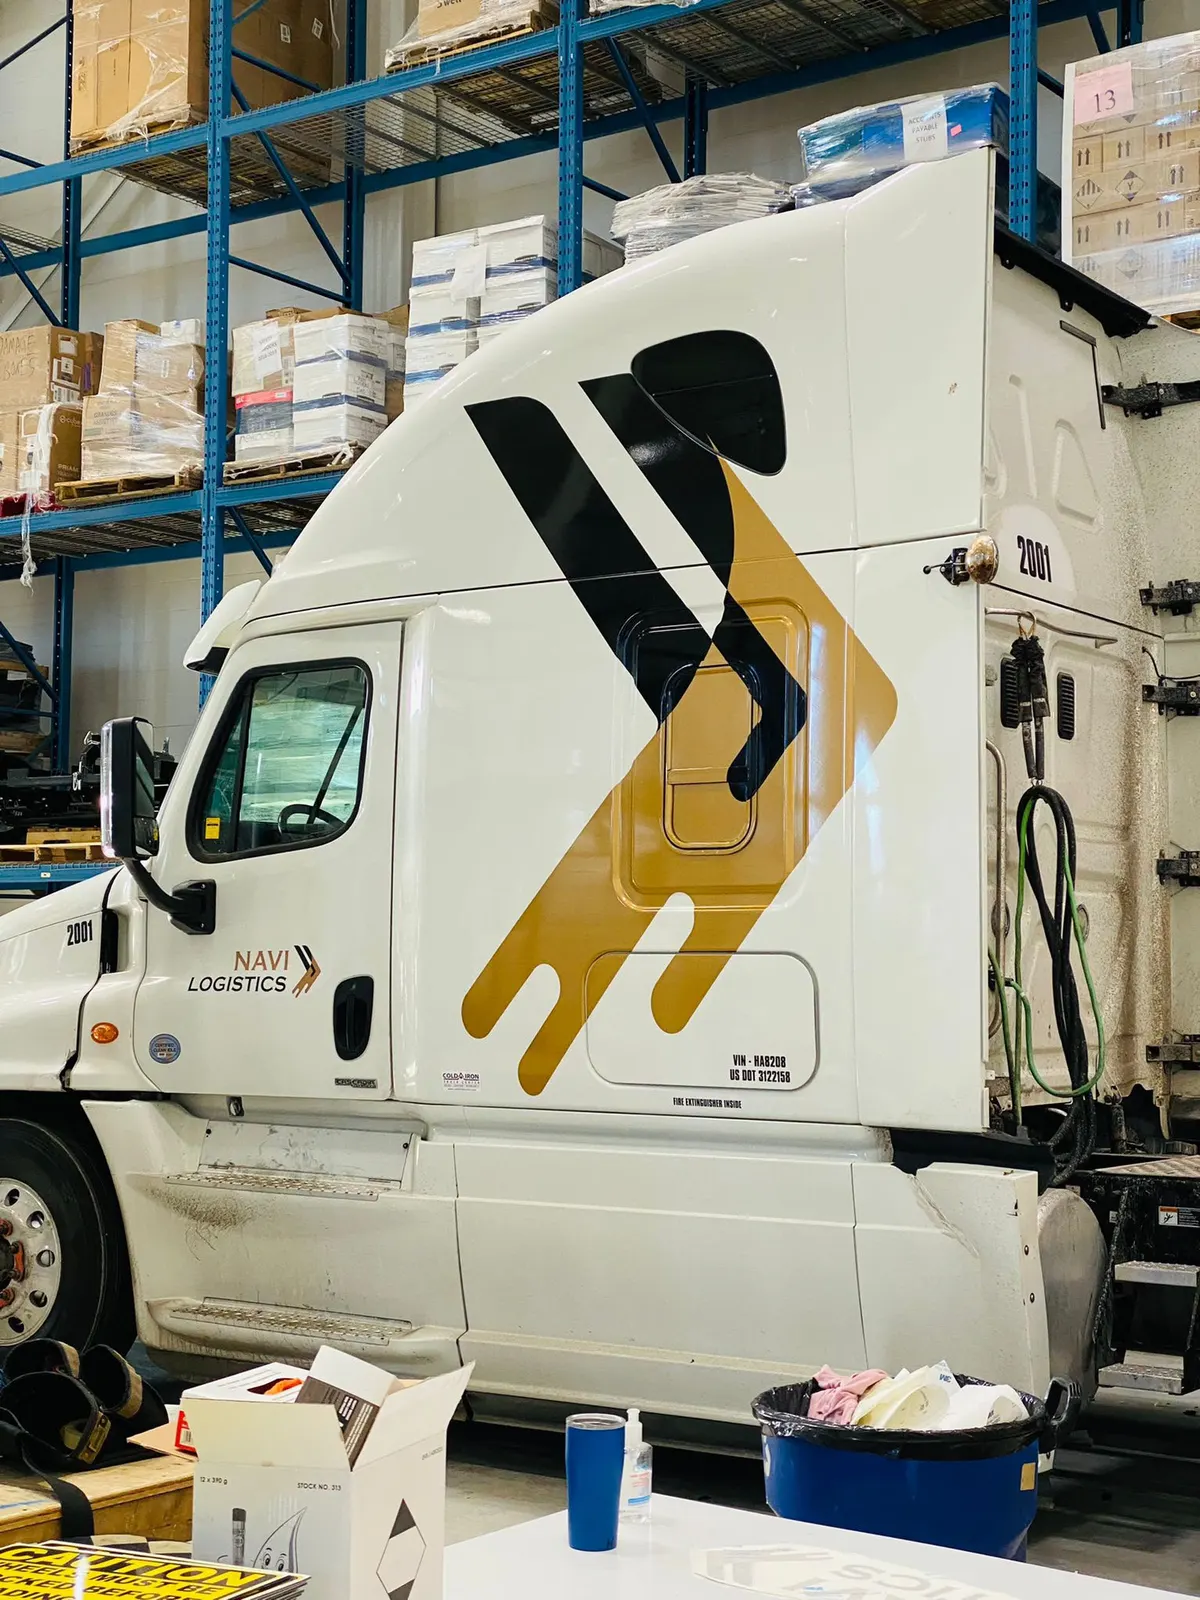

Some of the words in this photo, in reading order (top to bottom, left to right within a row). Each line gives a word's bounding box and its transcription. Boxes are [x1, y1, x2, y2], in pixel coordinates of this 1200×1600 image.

[1094, 89, 1116, 113] 13
[908, 112, 941, 125] ACCONTS
[911, 122, 938, 134] PAYABLE
[915, 134, 936, 143] STUBS
[1016, 534, 1052, 583] 2001
[66, 919, 93, 946] 2001
[233, 950, 289, 971] NAVI
[187, 976, 287, 992] LOGISTICS
[732, 1054, 746, 1067] VIN
[754, 1055, 787, 1068] HA8208
[442, 1072, 460, 1080] COLD
[729, 1069, 740, 1081] US
[742, 1069, 756, 1082] DOT
[758, 1070, 791, 1083] 3122158
[673, 1097, 685, 1106] FIRE
[685, 1098, 723, 1108] EXTINGUISHER
[723, 1099, 742, 1109] INSIDE
[297, 1482, 317, 1490] STOCK
[0, 1547, 267, 1588] CAUTION
[0, 1561, 89, 1578] HEELS
[88, 1573, 179, 1589] MUST
[176, 1584, 219, 1595] BE
[0, 1574, 76, 1590] CKED
